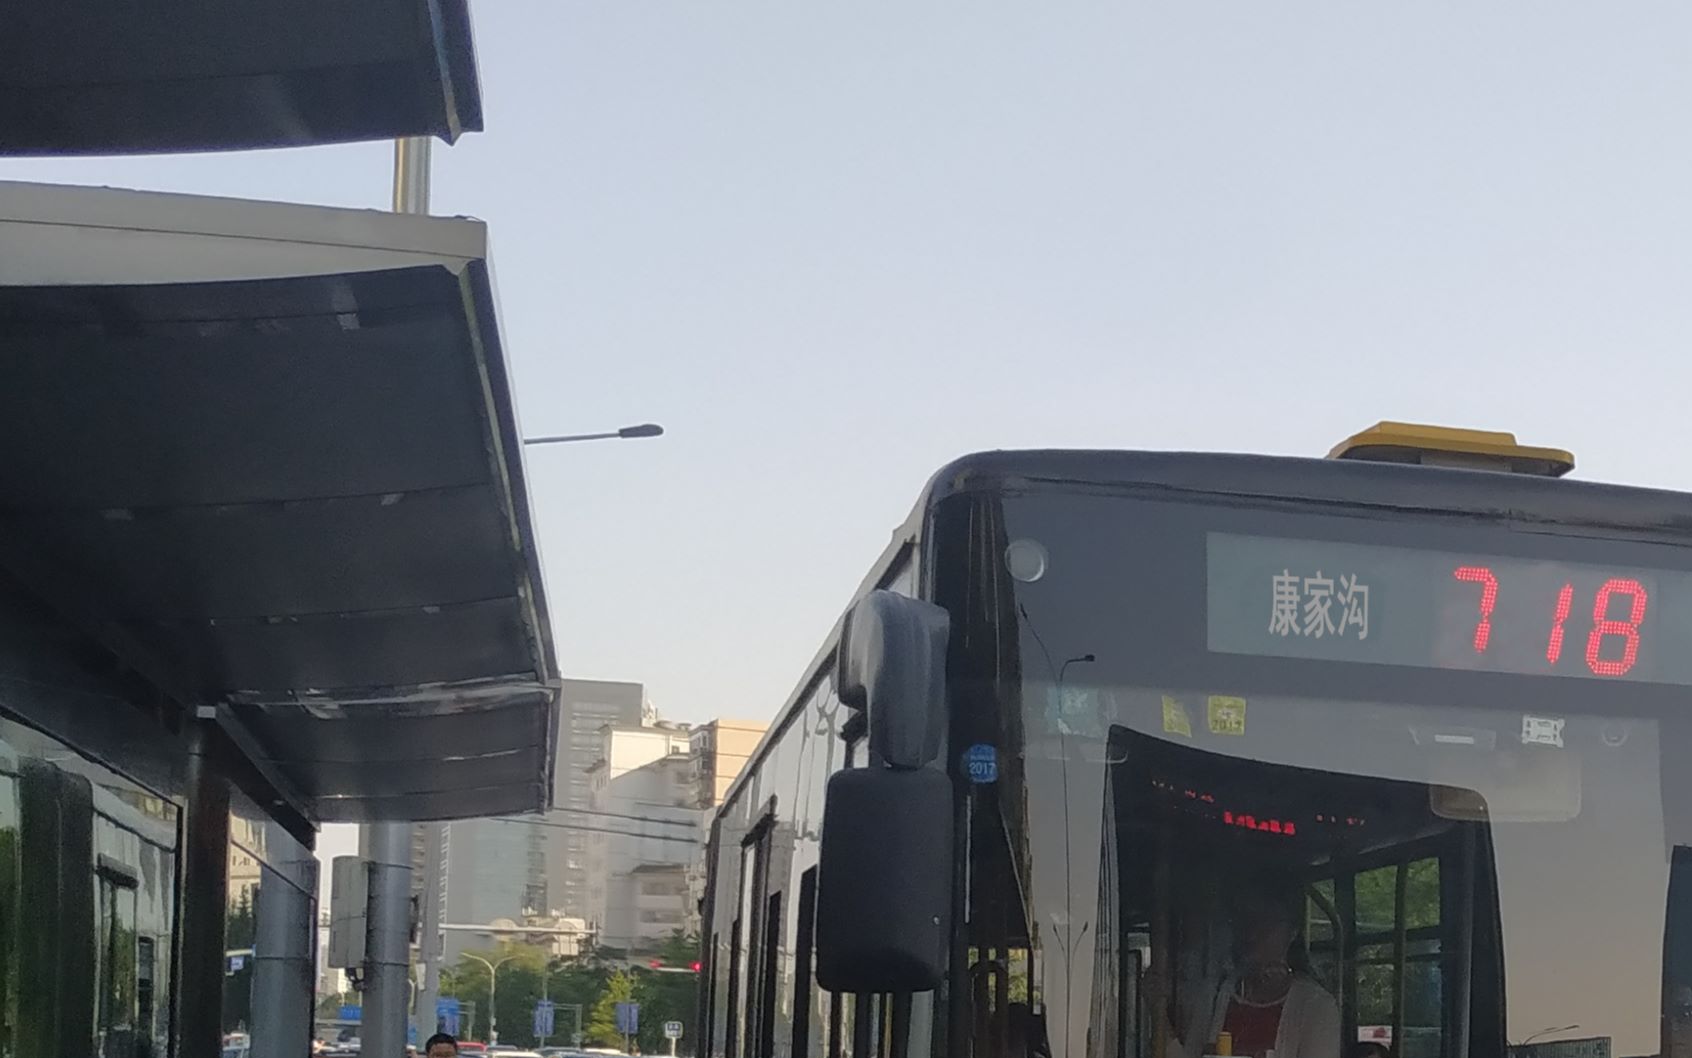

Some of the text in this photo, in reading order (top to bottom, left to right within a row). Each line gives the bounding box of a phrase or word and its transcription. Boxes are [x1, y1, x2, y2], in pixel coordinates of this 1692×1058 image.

[1268, 569, 1370, 640] 康家沟
[1453, 566, 1648, 677] 718
[968, 761, 996, 775] 2017
